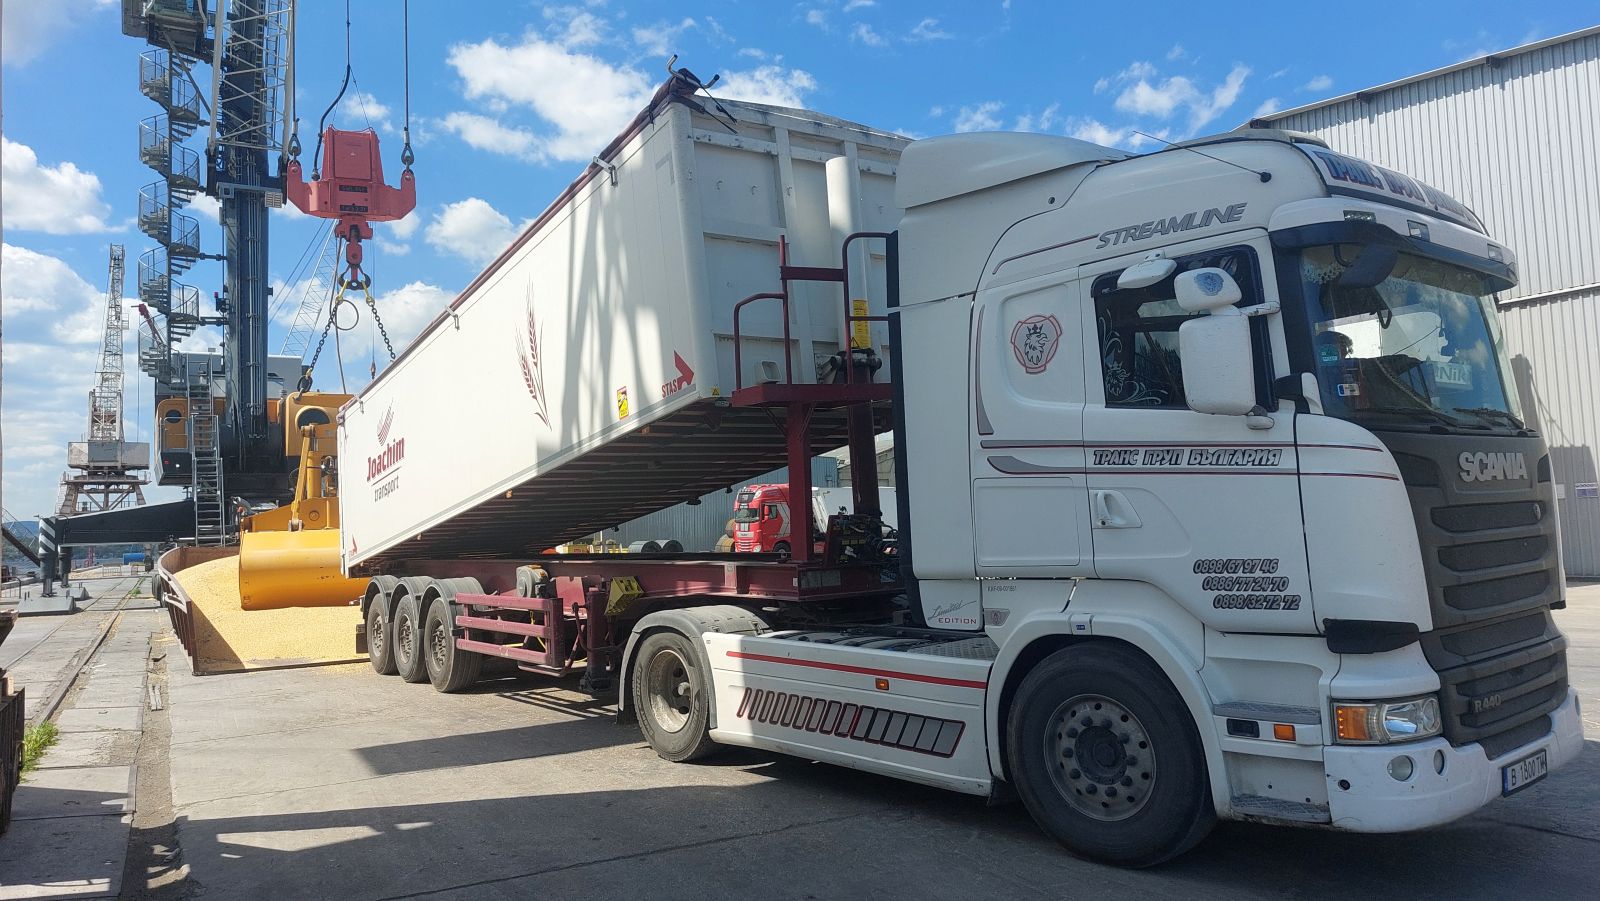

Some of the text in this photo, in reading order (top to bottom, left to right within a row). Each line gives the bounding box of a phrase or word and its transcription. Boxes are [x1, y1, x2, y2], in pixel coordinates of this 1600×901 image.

[1096, 202, 1248, 249] STREAMLINE
[661, 379, 678, 399] STAS
[366, 437, 405, 482] Joachim
[1094, 449, 1282, 466] ТРАНС ГРУП БЪЛГАРИЯ
[1459, 451, 1528, 482] SCANIA
[374, 474, 399, 503] transport
[1511, 768, 1517, 787] B
